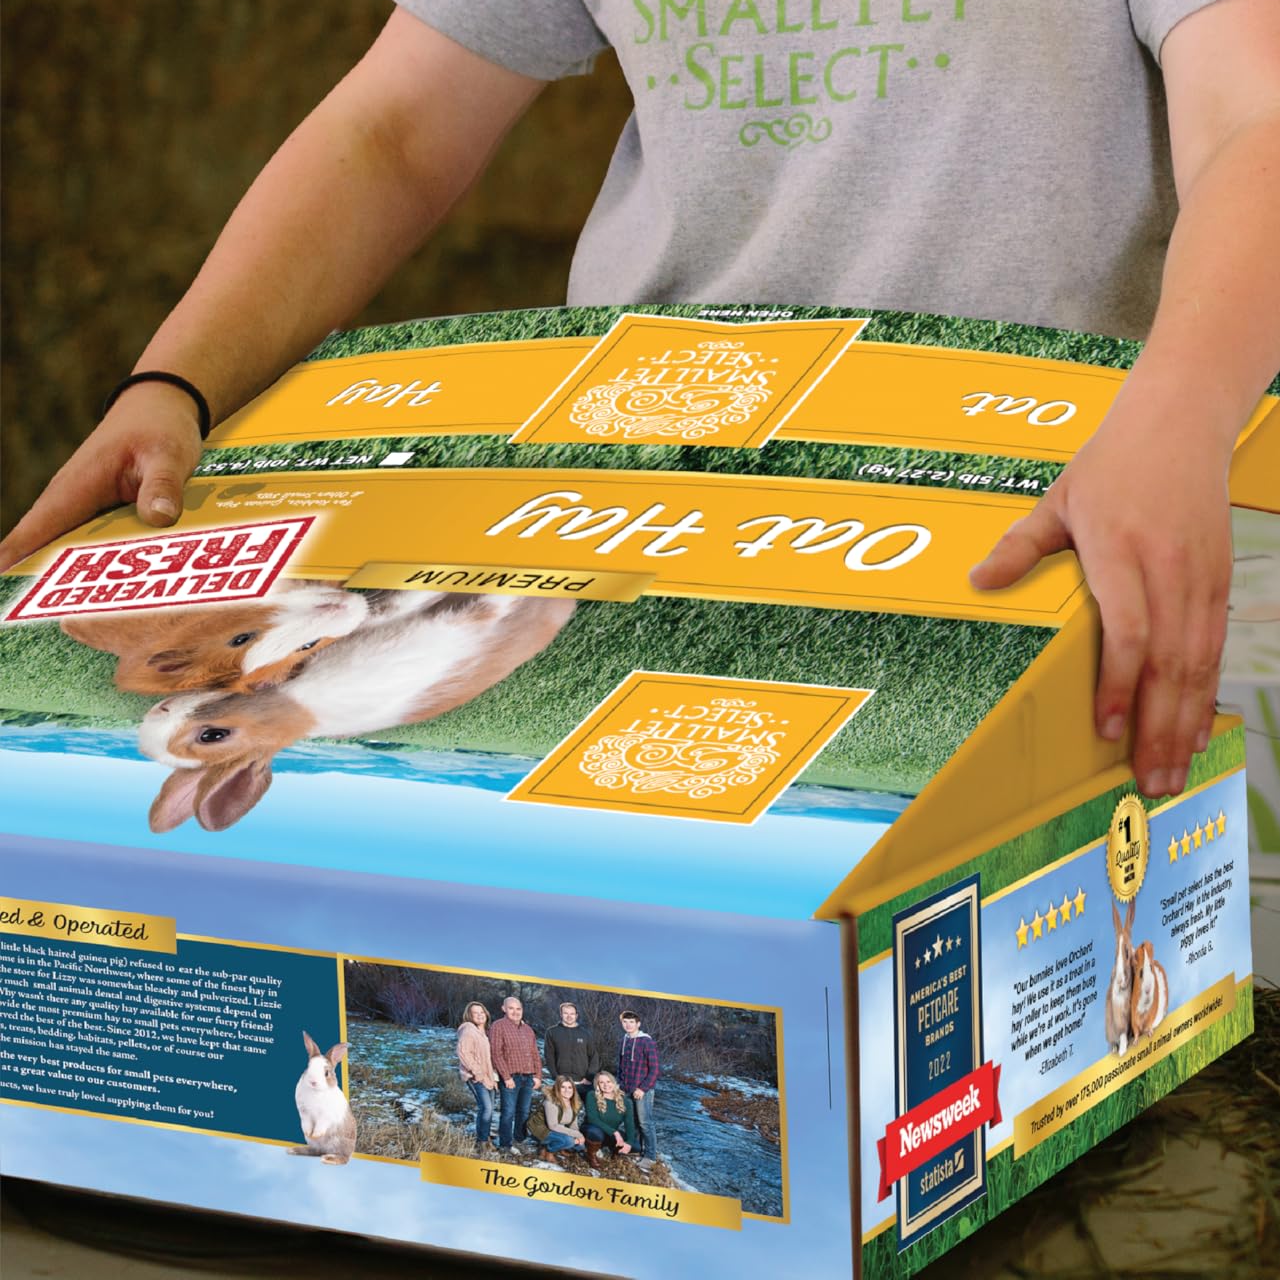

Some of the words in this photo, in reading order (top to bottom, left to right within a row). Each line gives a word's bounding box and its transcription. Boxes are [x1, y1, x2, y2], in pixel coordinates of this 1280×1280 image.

[683, 43, 904, 110] SELECT
[699, 309, 747, 317] HERE
[749, 310, 794, 318] OPEN
[651, 350, 762, 369] SELECT
[608, 368, 673, 385] PET
[676, 368, 777, 386] SMALL
[327, 378, 442, 410] Hay
[961, 392, 1077, 426] Oat
[254, 458, 292, 468] 10lb
[336, 455, 373, 465] NET
[859, 463, 895, 476] kg)
[899, 468, 954, 482] (2.27
[959, 473, 992, 485] 5lb
[486, 492, 705, 558] Hay
[55, 528, 280, 586] FRESH
[735, 513, 932, 572] Oat
[38, 568, 251, 609] DELIVERED
[404, 569, 595, 593] PREMIUM
[619, 720, 683, 738] PET
[664, 704, 774, 729] SELECT
[686, 723, 786, 746] SMALL
[1116, 840, 1140, 868] Quality
[28, 911, 45, 927] &
[53, 914, 150, 941] Operated
[1, 941, 21, 951] little
[23, 944, 46, 955] black
[48, 948, 76, 959] haired
[78, 954, 107, 963] guinea
[110, 957, 128, 967] pig)
[130, 959, 163, 970] refused
[195, 967, 209, 976] the
[212, 970, 248, 982] sub-par
[249, 976, 282, 988] quality
[27, 957, 35, 965] in
[37, 958, 51, 967] the
[54, 960, 82, 971] Pacific
[84, 964, 135, 979] Northwest,
[137, 972, 164, 982] where
[167, 977, 190, 985] some
[192, 979, 202, 987] of
[204, 980, 219, 989] the
[221, 982, 246, 992] finest
[249, 985, 265, 997] hay
[268, 988, 277, 997] in
[1013, 979, 1028, 995] "Our
[1028, 965, 1053, 987] bunnies
[1055, 957, 1067, 972] love
[1068, 939, 1093, 963] Orchard
[910, 975, 948, 1005] AMERICA'S
[949, 964, 967, 984] BEST
[918, 987, 959, 1033] PETCARE
[1010, 1018, 1023, 1034] hay
[1024, 1007, 1041, 1026] roller
[1041, 1003, 1048, 1015] to
[1049, 993, 1064, 1010] keep
[1065, 983, 1081, 1000] them
[1082, 974, 1096, 990] busy
[20, 1013, 34, 1021] the
[36, 1014, 54, 1024] best
[57, 1018, 66, 1026] of
[68, 1019, 82, 1028] the
[84, 1021, 105, 1031] best.
[107, 1025, 131, 1035] Since
[134, 1028, 160, 1040] 2012,
[176, 1034, 197, 1044] have
[199, 1037, 219, 1049] kept
[222, 1041, 240, 1051] that
[244, 1046, 266, 1054] same
[925, 1020, 955, 1047] BRANDS
[17, 1054, 38, 1065] very
[40, 1055, 60, 1066] best
[63, 1061, 105, 1073] products
[107, 1065, 122, 1075] for
[124, 1070, 151, 1079] small
[153, 1074, 174, 1083] pets
[176, 1078, 237, 1093] everywhere,
[929, 1051, 951, 1080] 2022
[1030, 1106, 1054, 1134] Trusted
[1055, 1104, 1064, 1118] by
[1064, 1093, 1079, 1111] over
[1080, 1075, 1103, 1101] 175,000
[1103, 1055, 1136, 1088] passionate
[1136, 1040, 1152, 1062] small
[1152, 1027, 1172, 1051] animal
[1172, 1017, 1192, 1037] owners
[1193, 995, 1222, 1023] worldwide!
[36, 1084, 56, 1094] have
[58, 1089, 79, 1100] truly
[81, 1091, 105, 1102] loved
[107, 1098, 151, 1111] supplying
[152, 1102, 176, 1113] them
[178, 1106, 192, 1115] for
[193, 1110, 214, 1118] you!
[899, 1084, 981, 1158] Newsweek
[480, 1168, 520, 1189] The
[524, 1175, 603, 1201] Gordon
[607, 1187, 679, 1216] Family
[920, 1159, 954, 1196] statista
